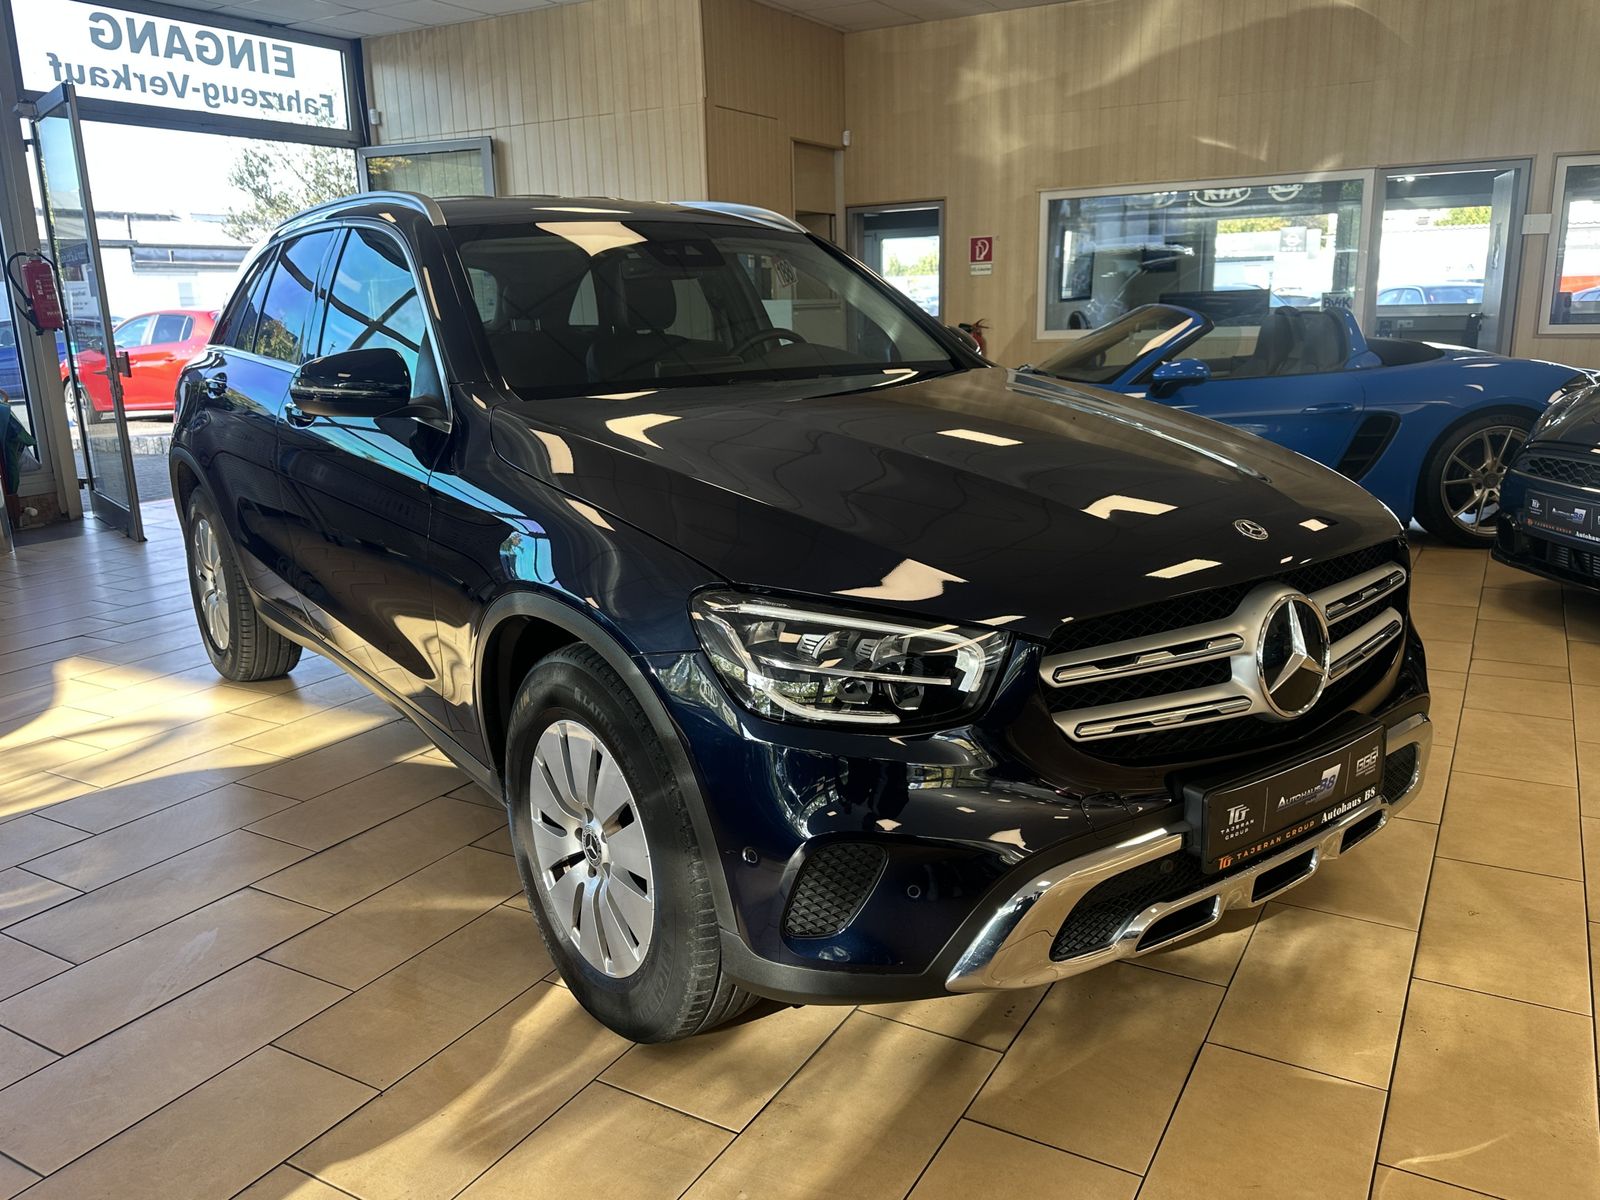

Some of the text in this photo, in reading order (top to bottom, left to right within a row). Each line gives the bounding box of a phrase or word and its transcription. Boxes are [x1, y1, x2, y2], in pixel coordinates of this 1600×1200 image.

[1225, 828, 1249, 840] GROUP
[1237, 836, 1281, 860] TAJERAN
[1286, 820, 1315, 838] GROUP
[1321, 797, 1361, 824] Autohaus
